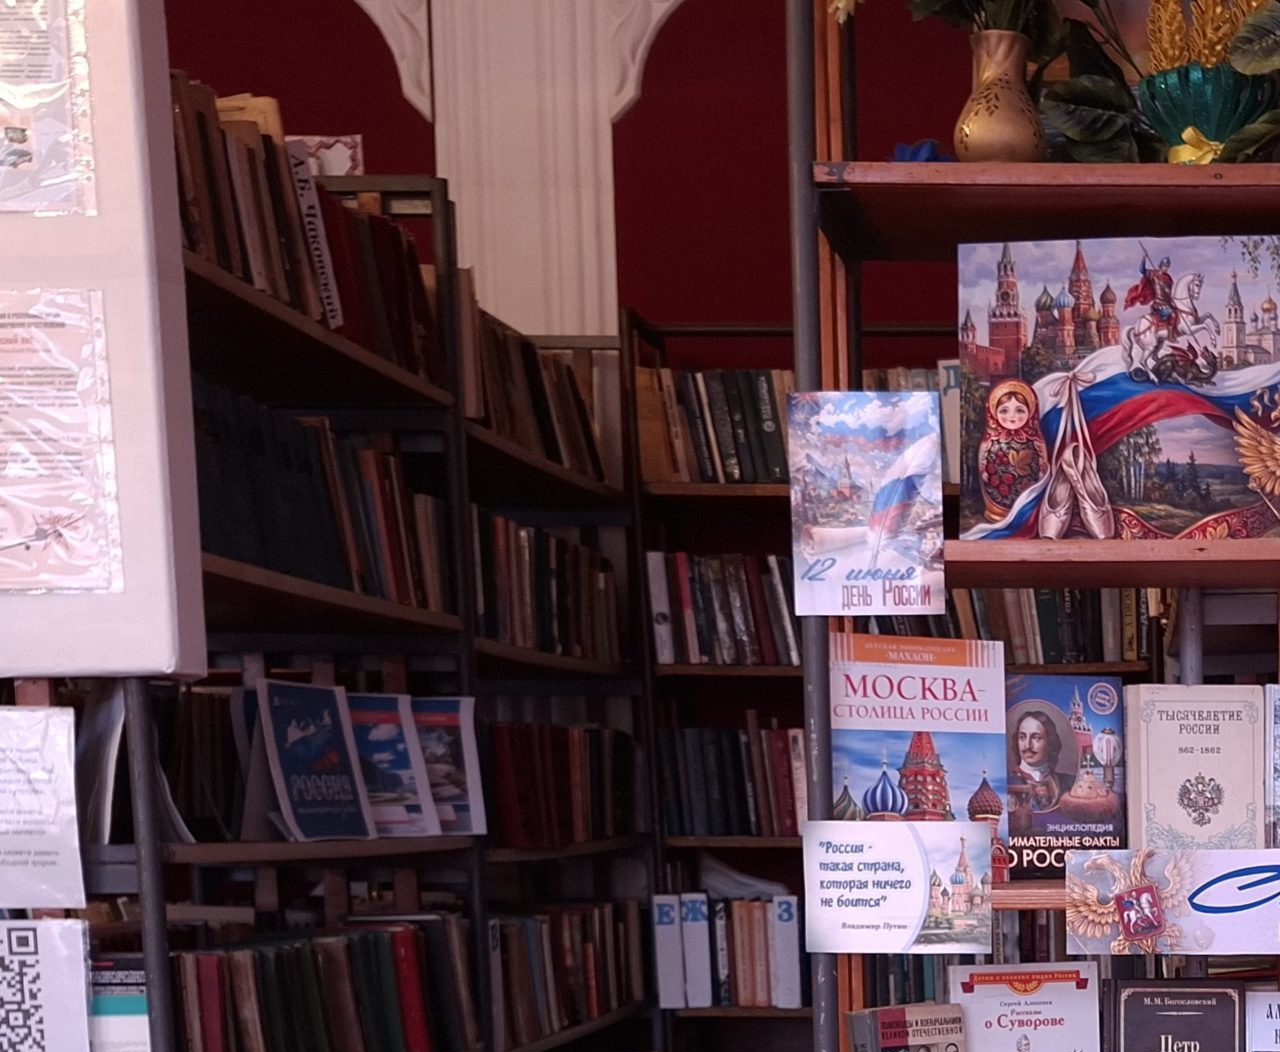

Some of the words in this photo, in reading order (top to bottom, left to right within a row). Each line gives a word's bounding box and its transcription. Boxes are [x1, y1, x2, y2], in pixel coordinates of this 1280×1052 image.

[801, 557, 837, 582] 12
[845, 565, 918, 582] июня
[833, 704, 915, 720] СТОЛИЦА
[921, 707, 989, 722] РОССИИ
[1156, 710, 1244, 721] ТЫСЯЧЕЛЕТИЕ
[1178, 723, 1221, 735] РОССИИ
[1178, 746, 1222, 754] 862-1862
[1046, 823, 1114, 833] ЭНЦИКЛОПЕДИЯ
[1082, 836, 1120, 847] ФАКТЫ
[819, 861, 854, 872] такая
[857, 861, 905, 875] страна,
[819, 880, 869, 893] которая
[872, 880, 912, 890] ничего
[820, 897, 834, 908] не
[985, 1020, 993, 1029] о
[997, 1014, 1065, 1032] Суворове
